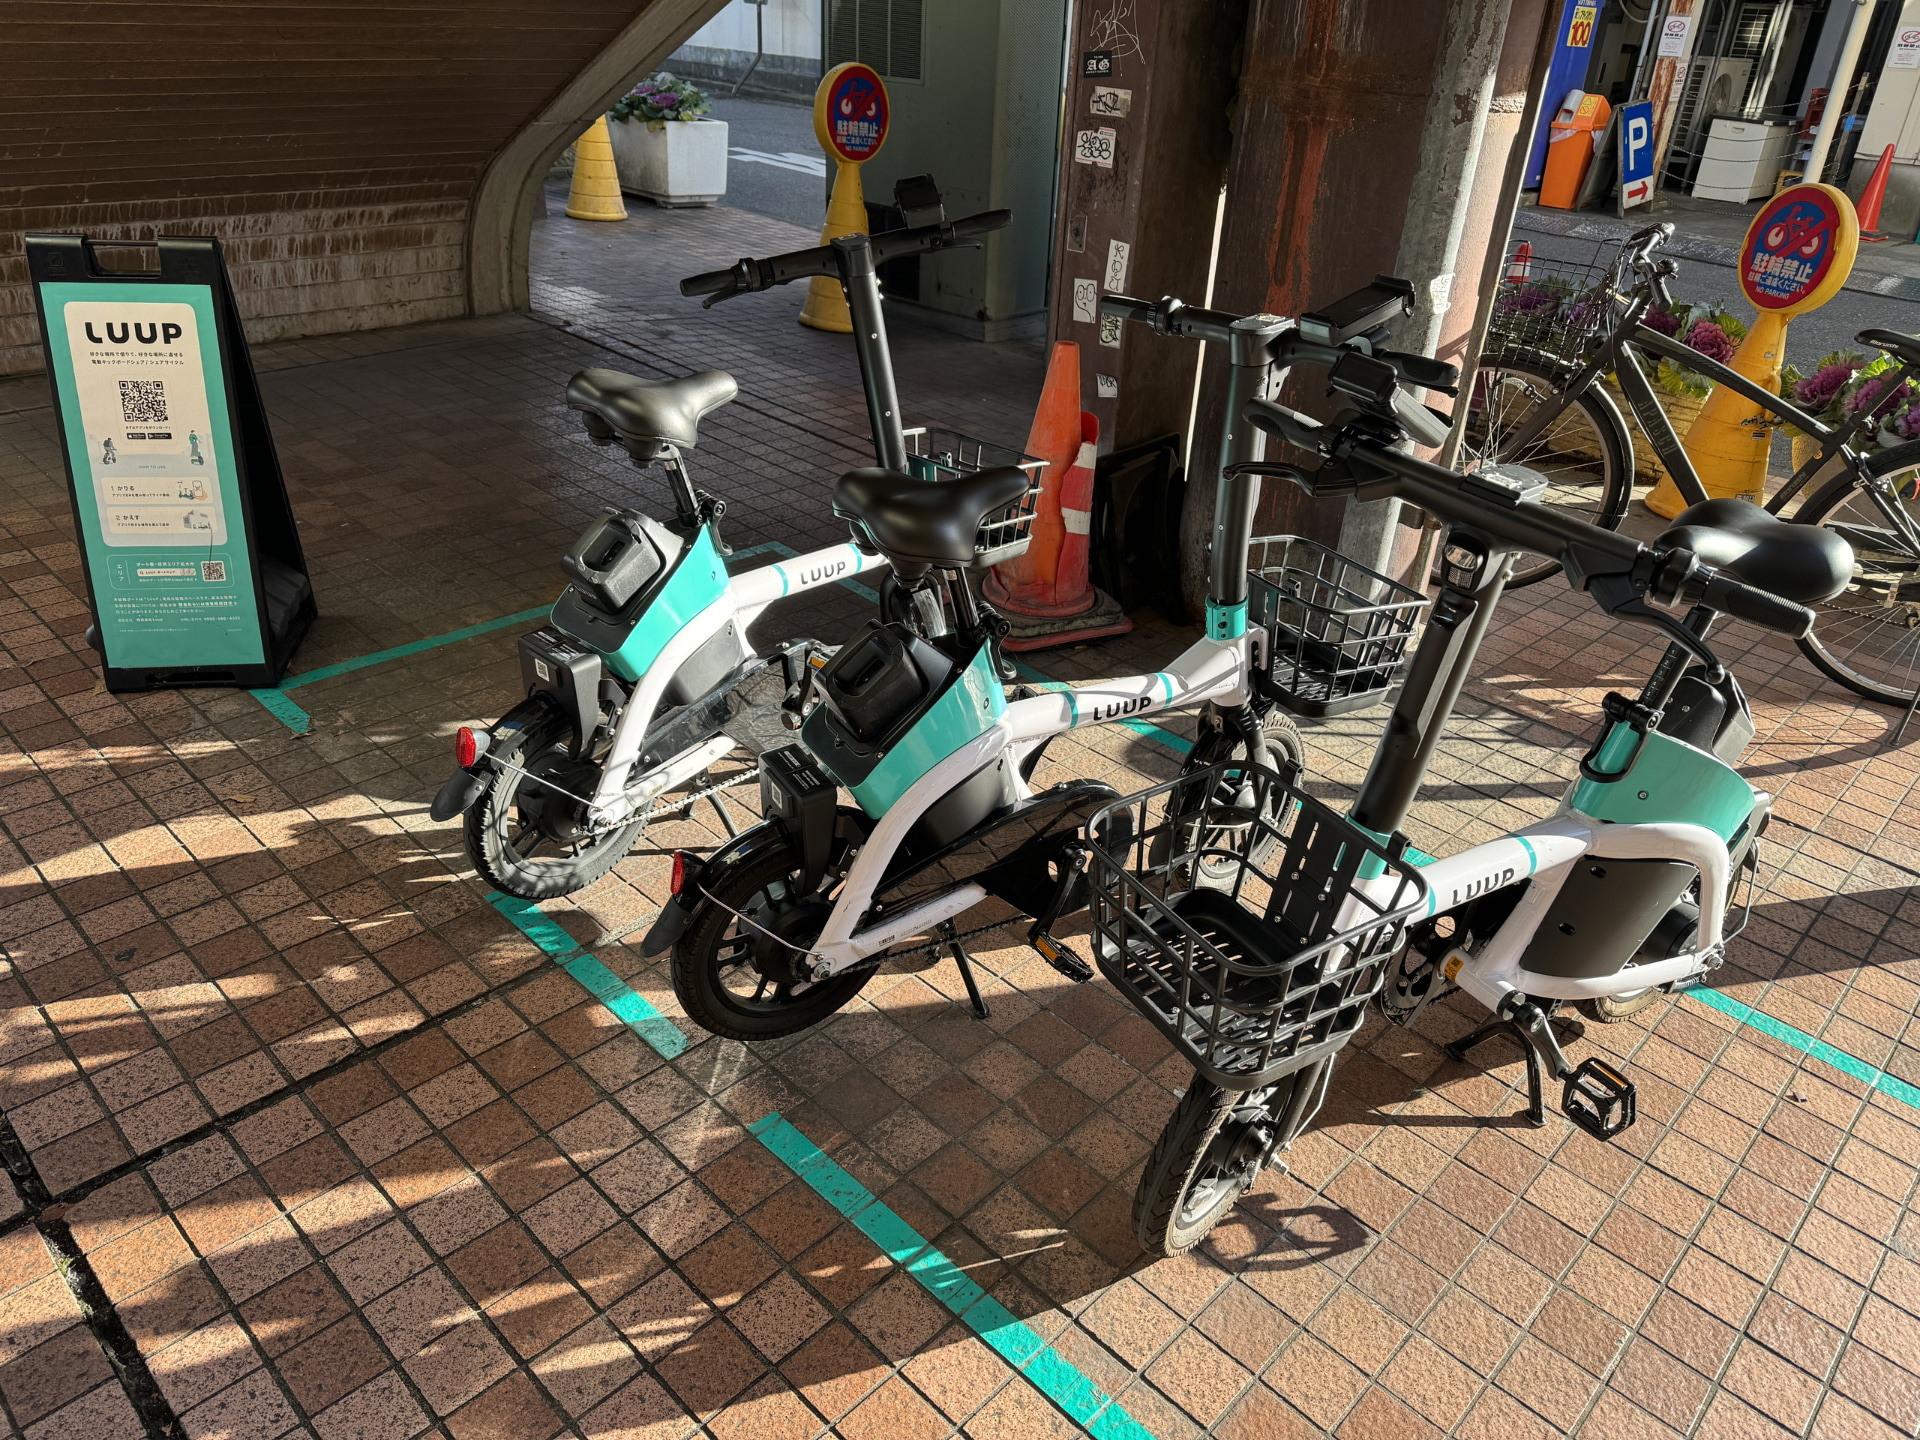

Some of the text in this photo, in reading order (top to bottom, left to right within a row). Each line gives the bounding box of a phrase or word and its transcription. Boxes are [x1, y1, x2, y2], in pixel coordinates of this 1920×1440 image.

[1570, 21, 1592, 46] 100
[837, 119, 878, 138] 駐輪禁止
[1628, 117, 1648, 171] P
[1750, 251, 1813, 283] 駐輪禁止
[1755, 285, 1790, 300] NO PARKING
[85, 322, 182, 344] LUUP
[116, 564, 124, 582] エリア
[800, 561, 846, 585] LUUP
[1093, 696, 1152, 721] LUUP
[1452, 868, 1514, 905] LUUP
